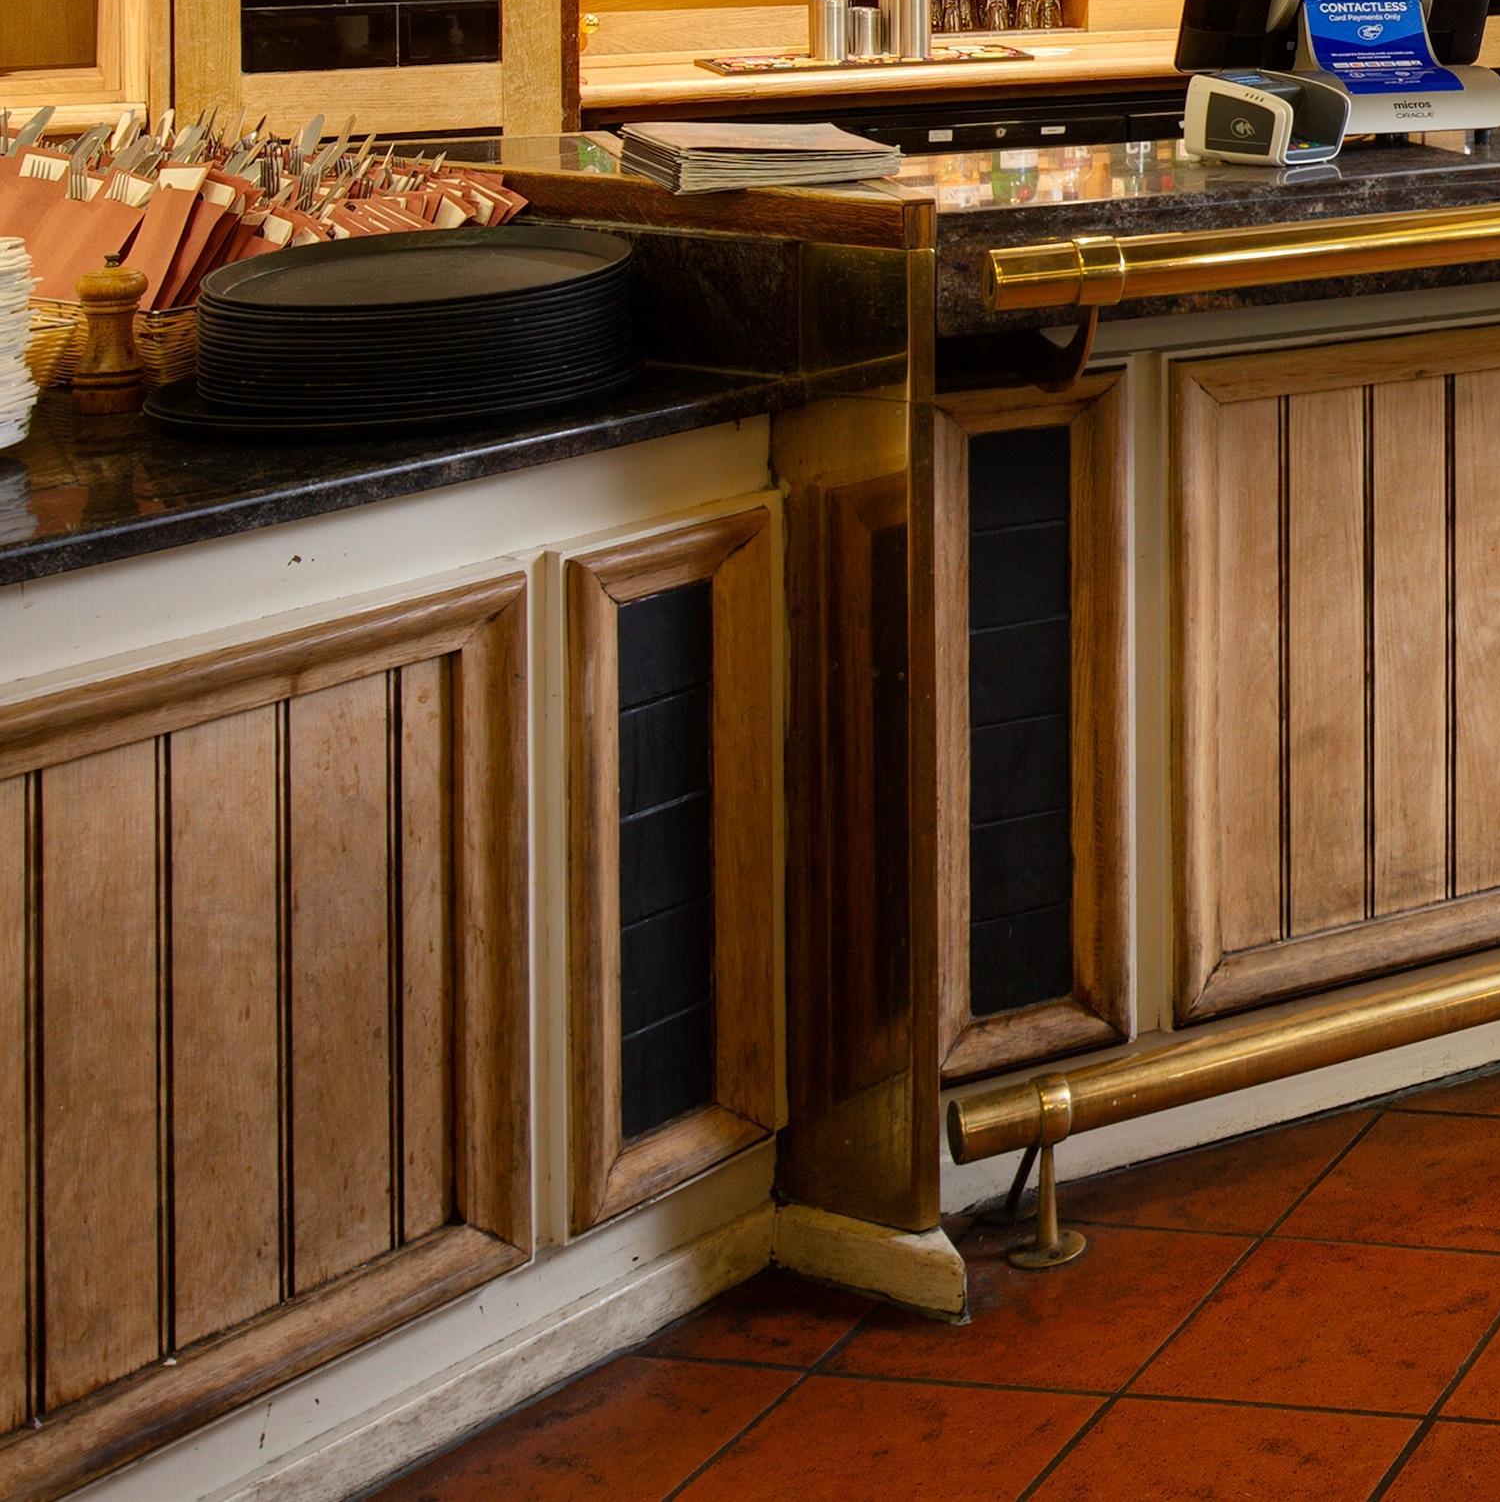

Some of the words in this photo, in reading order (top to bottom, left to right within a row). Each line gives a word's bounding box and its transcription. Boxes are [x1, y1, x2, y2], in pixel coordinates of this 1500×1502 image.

[1319, 1, 1408, 13] CONTACTLESS
[1328, 14, 1346, 22] Card
[1347, 14, 1383, 23] Payments
[1384, 13, 1401, 22] Only
[1393, 100, 1432, 109] micros
